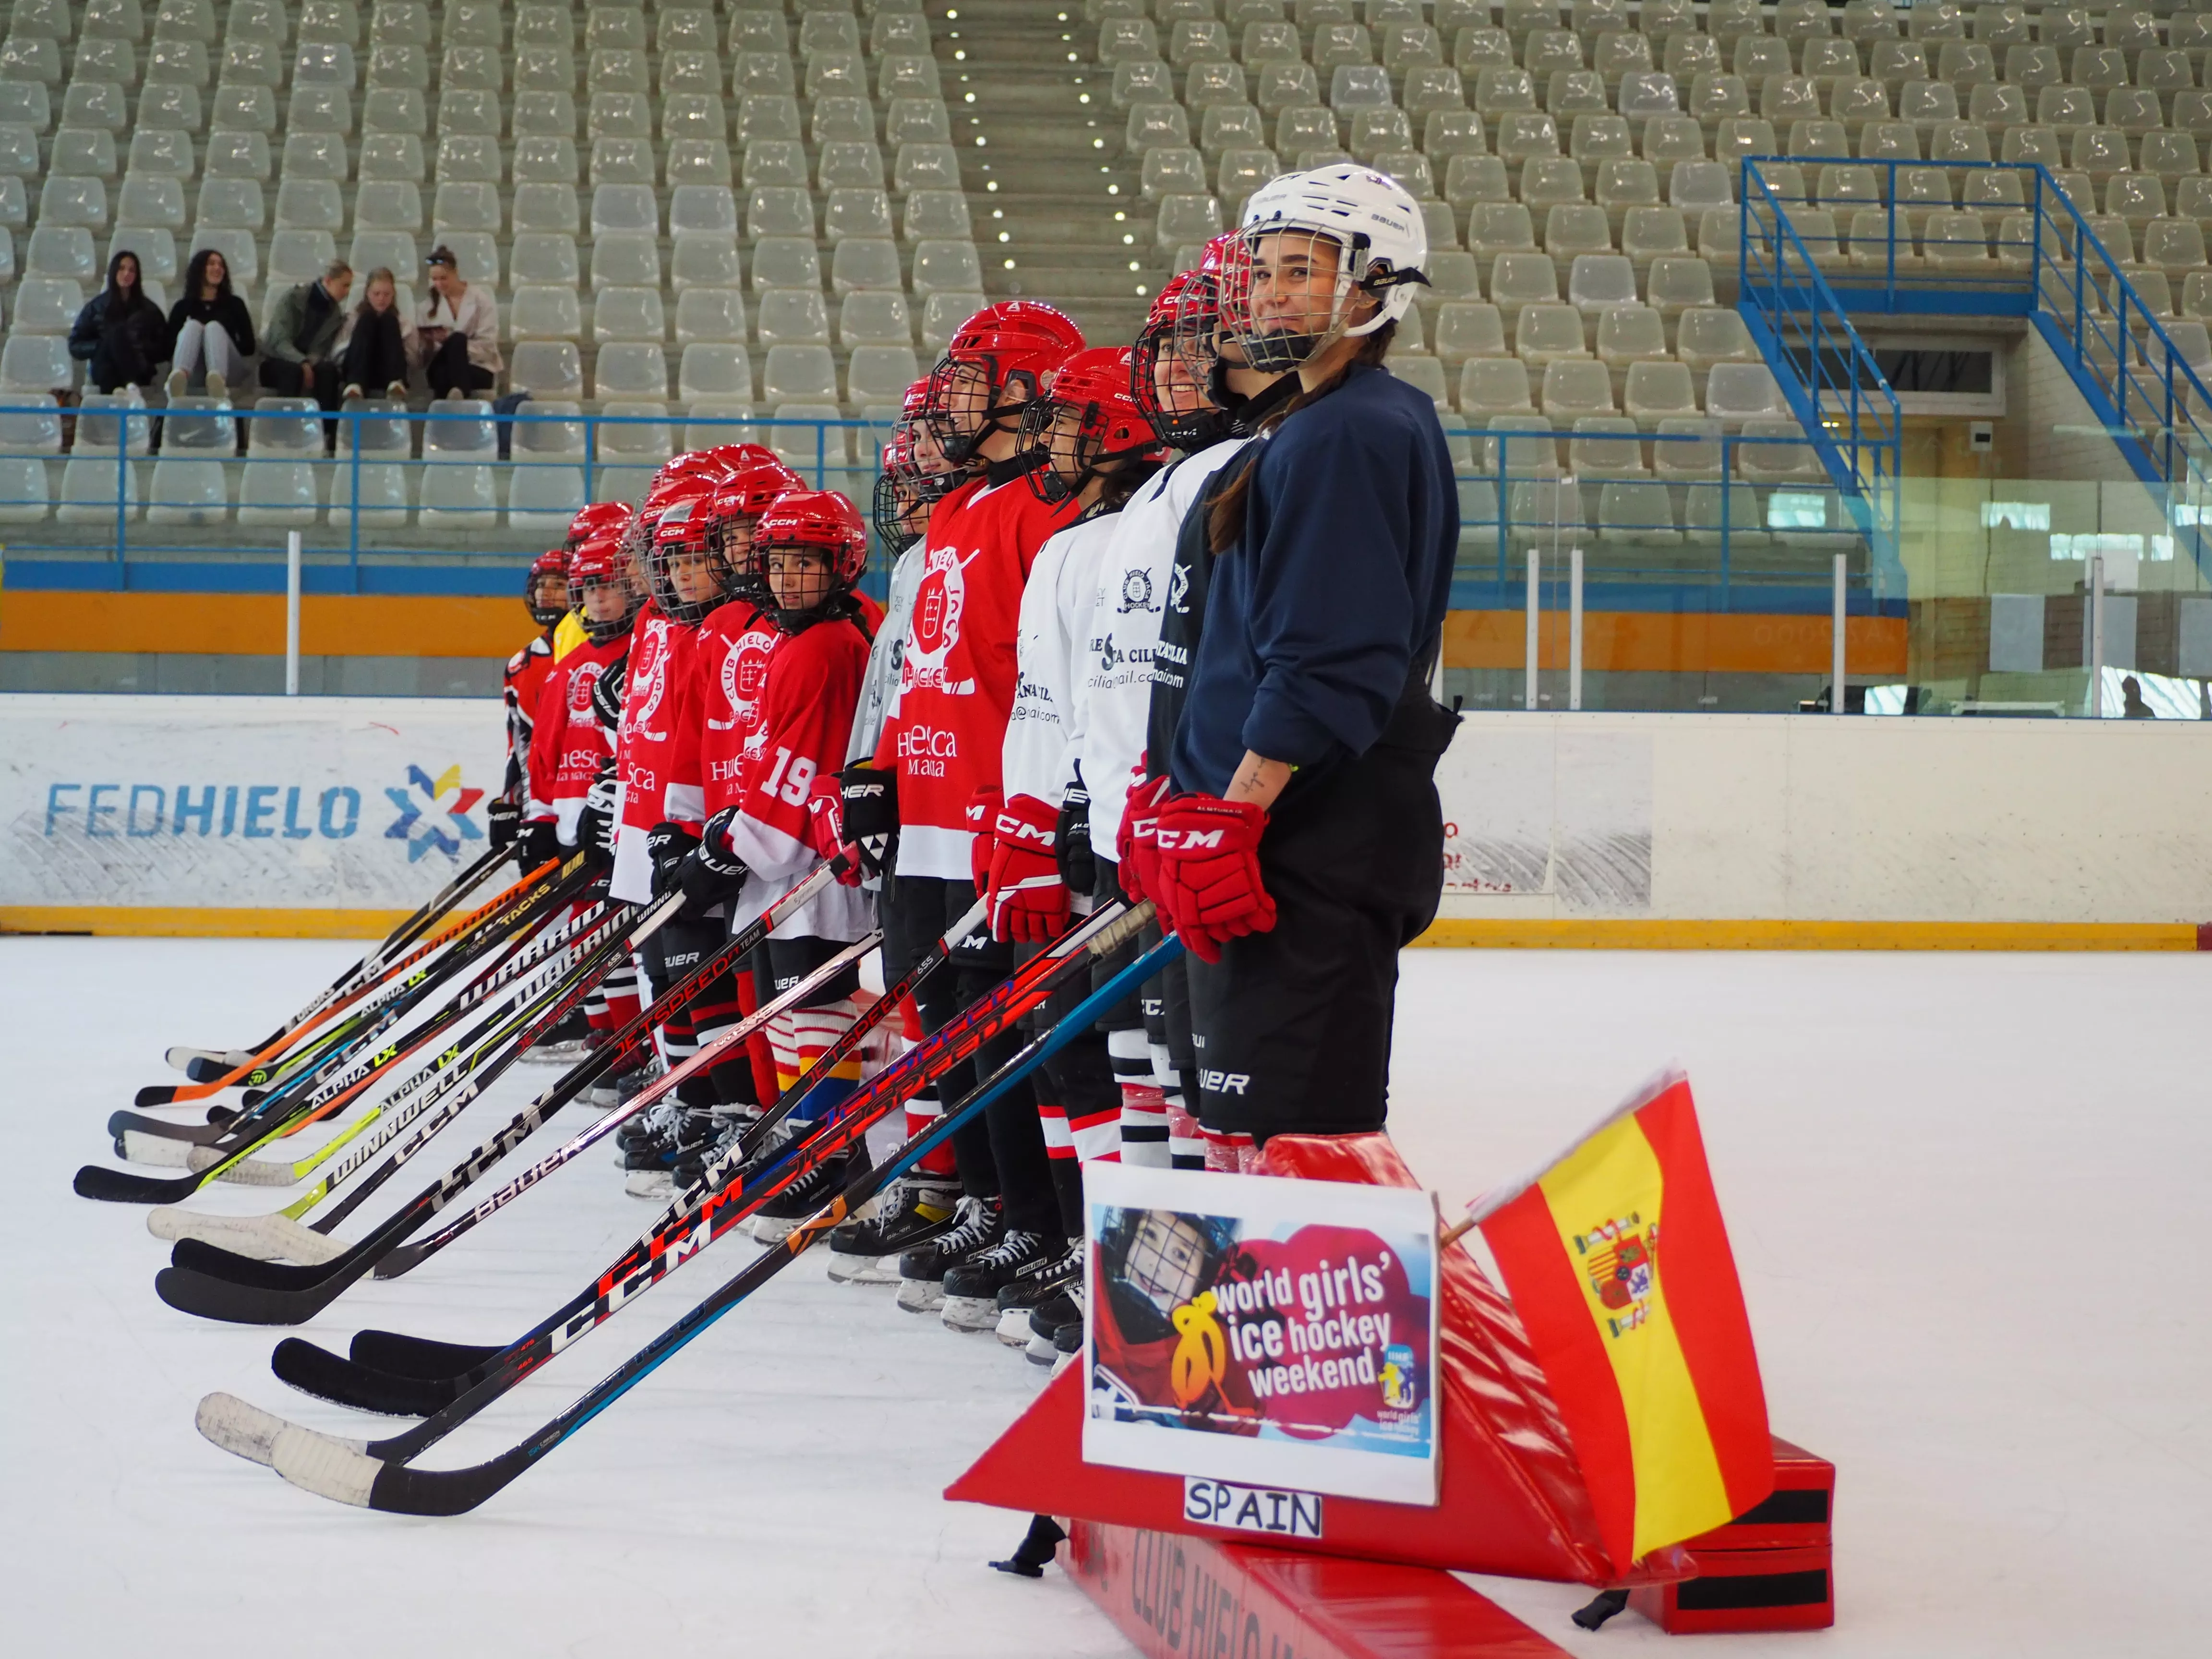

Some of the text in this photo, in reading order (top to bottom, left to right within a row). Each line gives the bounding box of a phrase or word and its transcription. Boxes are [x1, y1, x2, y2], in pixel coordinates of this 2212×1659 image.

[1371, 214, 1405, 231] BAUER
[660, 529, 685, 537] CCM
[769, 519, 798, 527] CCM
[580, 563, 603, 571] CCM
[735, 635, 772, 654] HIELO
[723, 658, 735, 700] CLUB
[760, 745, 817, 807] 19
[841, 784, 884, 799] HER
[44, 782, 361, 839] FEDHIELO
[996, 814, 1056, 847] CM
[1157, 829, 1225, 849] CM
[499, 882, 551, 926] TACKS
[360, 984, 406, 1018] ALPHA
[409, 968, 427, 986] LX
[612, 957, 728, 1063] JETSPEED
[740, 928, 761, 951] TEAM
[775, 975, 799, 990] UER
[804, 981, 908, 1093] JETSPEED
[917, 955, 934, 975] 655
[311, 1044, 397, 1110] ALPHA LX
[379, 1043, 460, 1116] ALPHA LX
[1200, 1068, 1250, 1095] UER
[333, 1065, 469, 1186] WINNWELL
[394, 1081, 480, 1165] CCM
[432, 1108, 542, 1212] CCM
[551, 1216, 711, 1355] CCM
[1017, 1258, 1046, 1276] BAUER
[1064, 1280, 1084, 1292] BAU
[1212, 1267, 1292, 1313] world
[520, 1338, 535, 1351] 475
[1229, 1311, 1391, 1362] ice hockey
[1247, 1347, 1376, 1399] weekend
[1186, 1481, 1322, 1536] SPAIN
